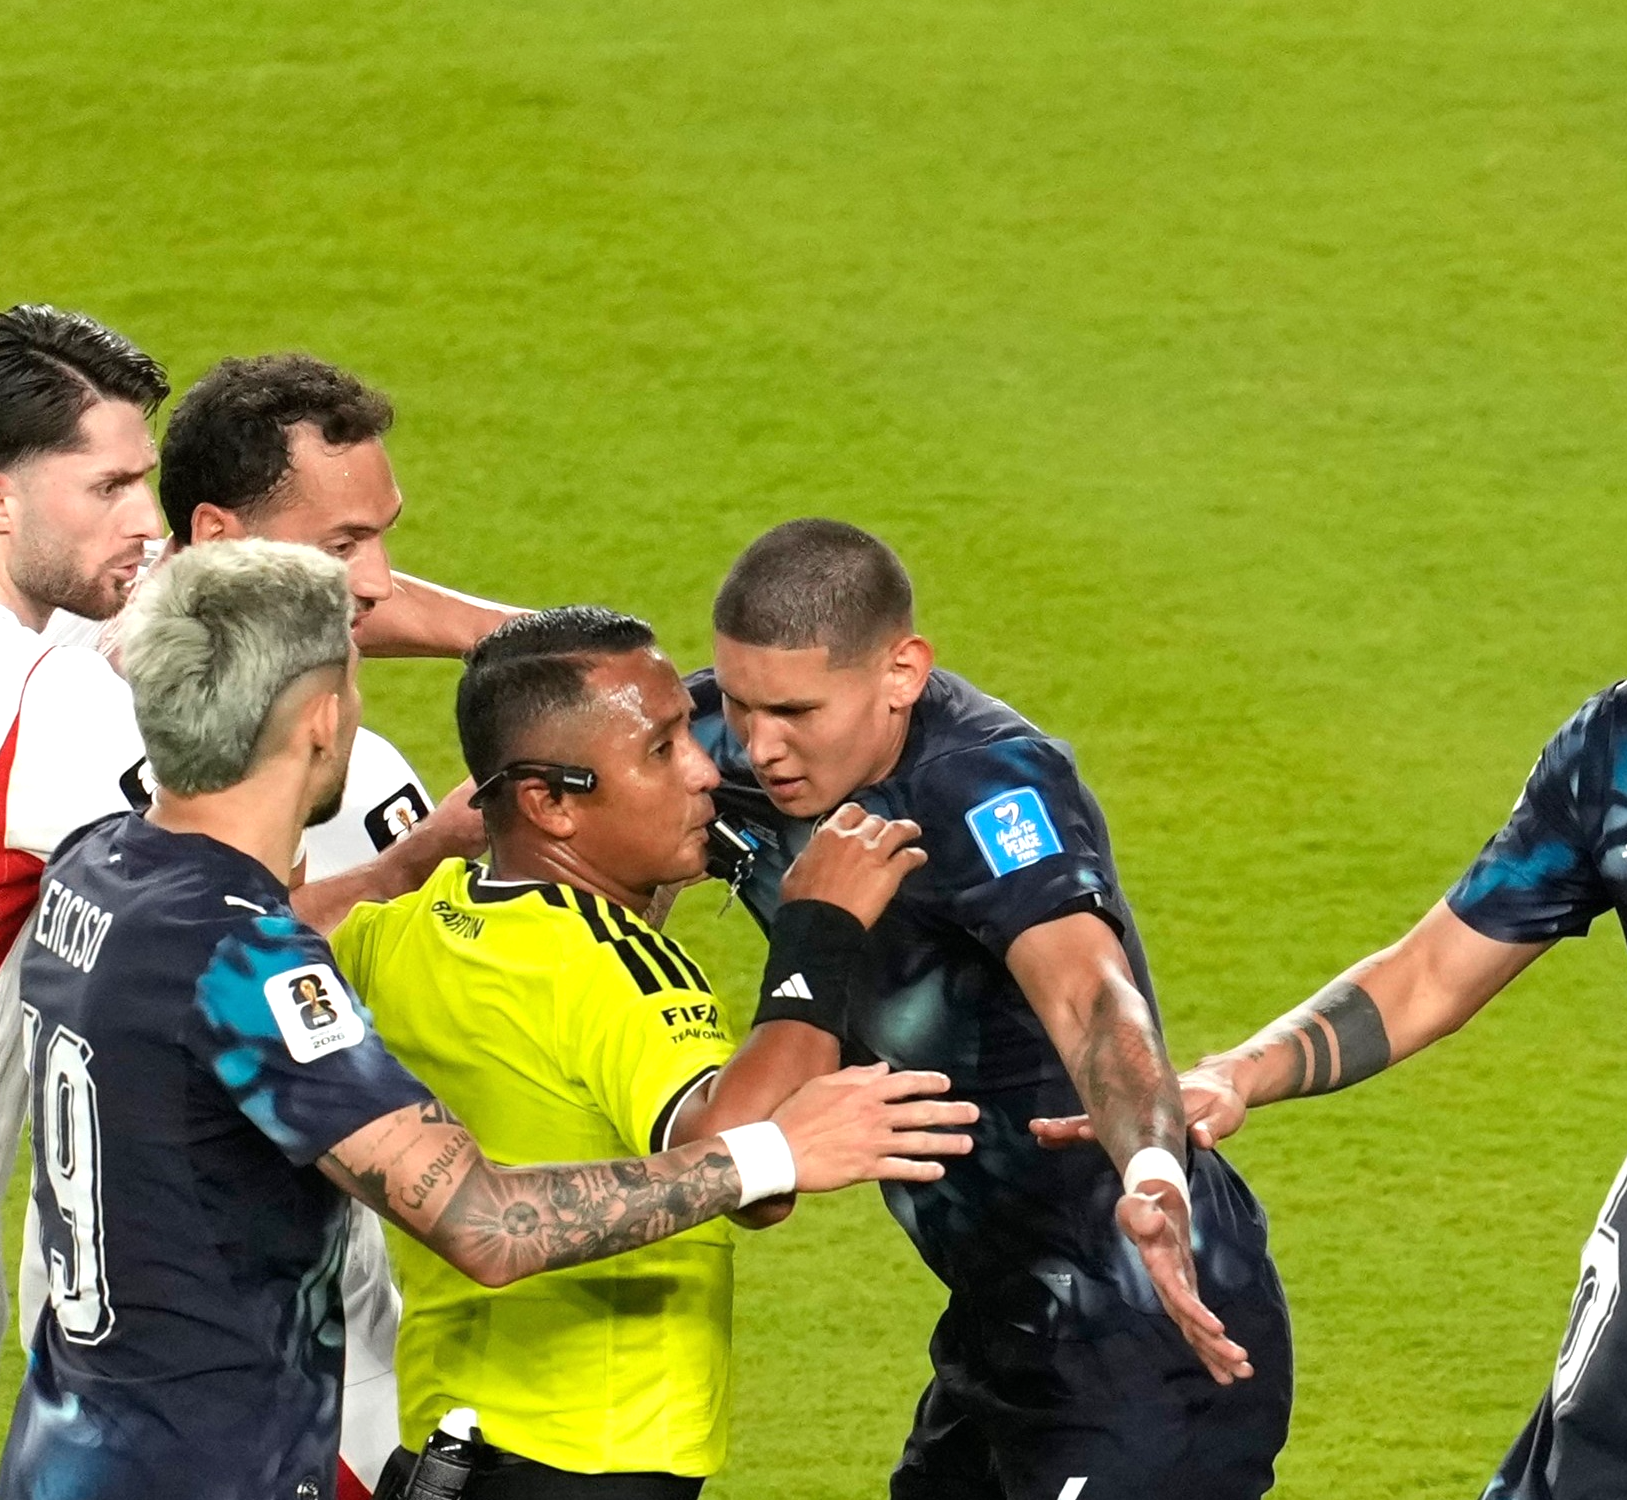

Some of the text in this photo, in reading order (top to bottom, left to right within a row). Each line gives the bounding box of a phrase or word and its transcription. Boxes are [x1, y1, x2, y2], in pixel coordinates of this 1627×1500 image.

[1003, 832, 1043, 858] PEACE
[35, 878, 114, 974] ENCISO
[660, 1003, 718, 1030] FIFA
[312, 1032, 346, 1049] 2026
